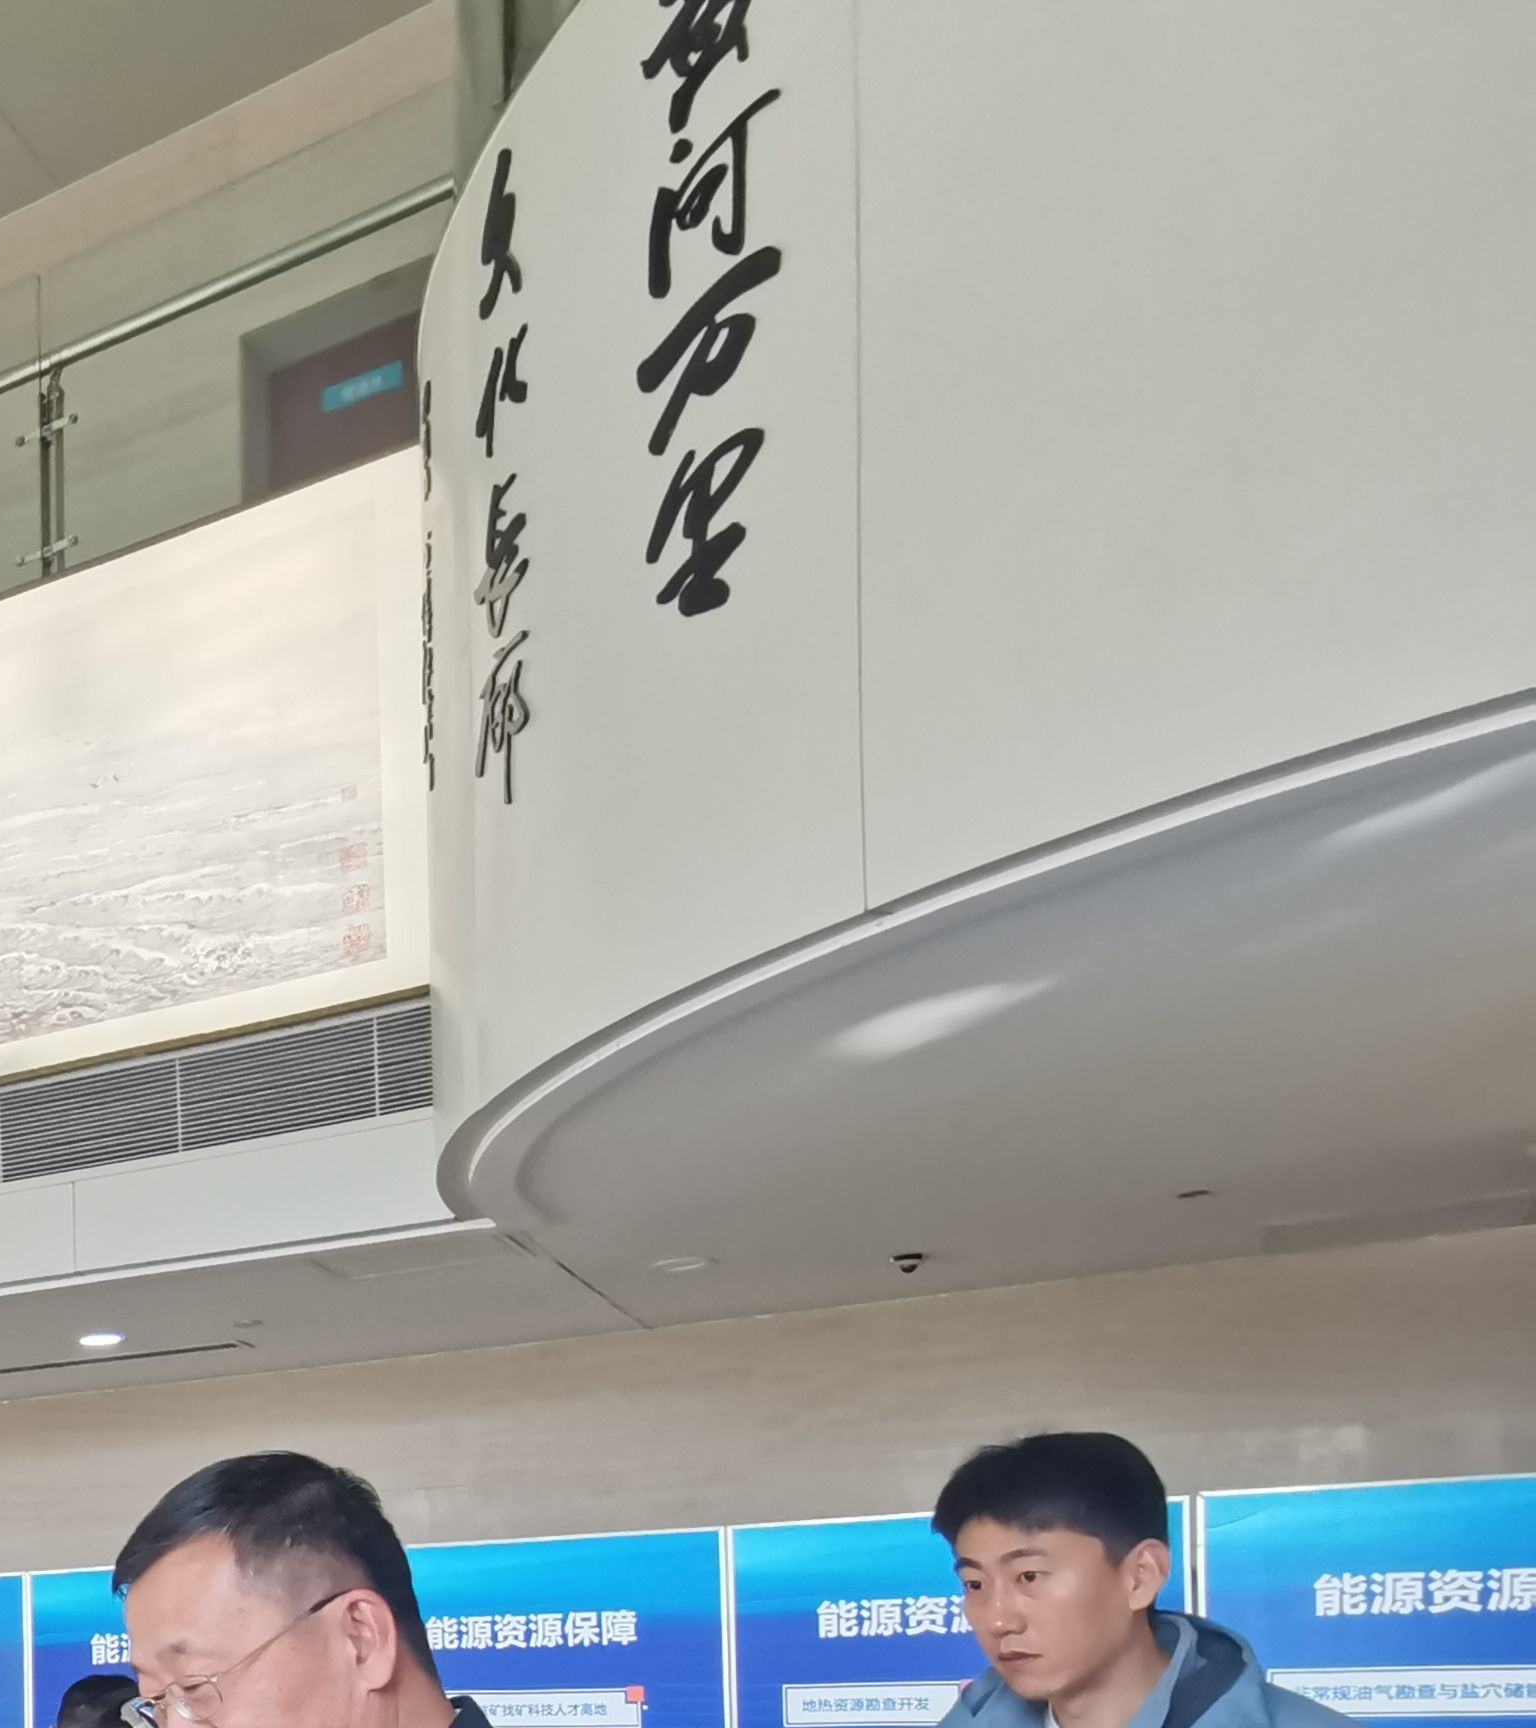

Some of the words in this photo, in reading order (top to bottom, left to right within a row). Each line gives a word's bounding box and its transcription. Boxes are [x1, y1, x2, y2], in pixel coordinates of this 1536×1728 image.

[427, 1610, 638, 1650] 能源资源保障
[801, 1697, 930, 1713] 地热资源勘查开发
